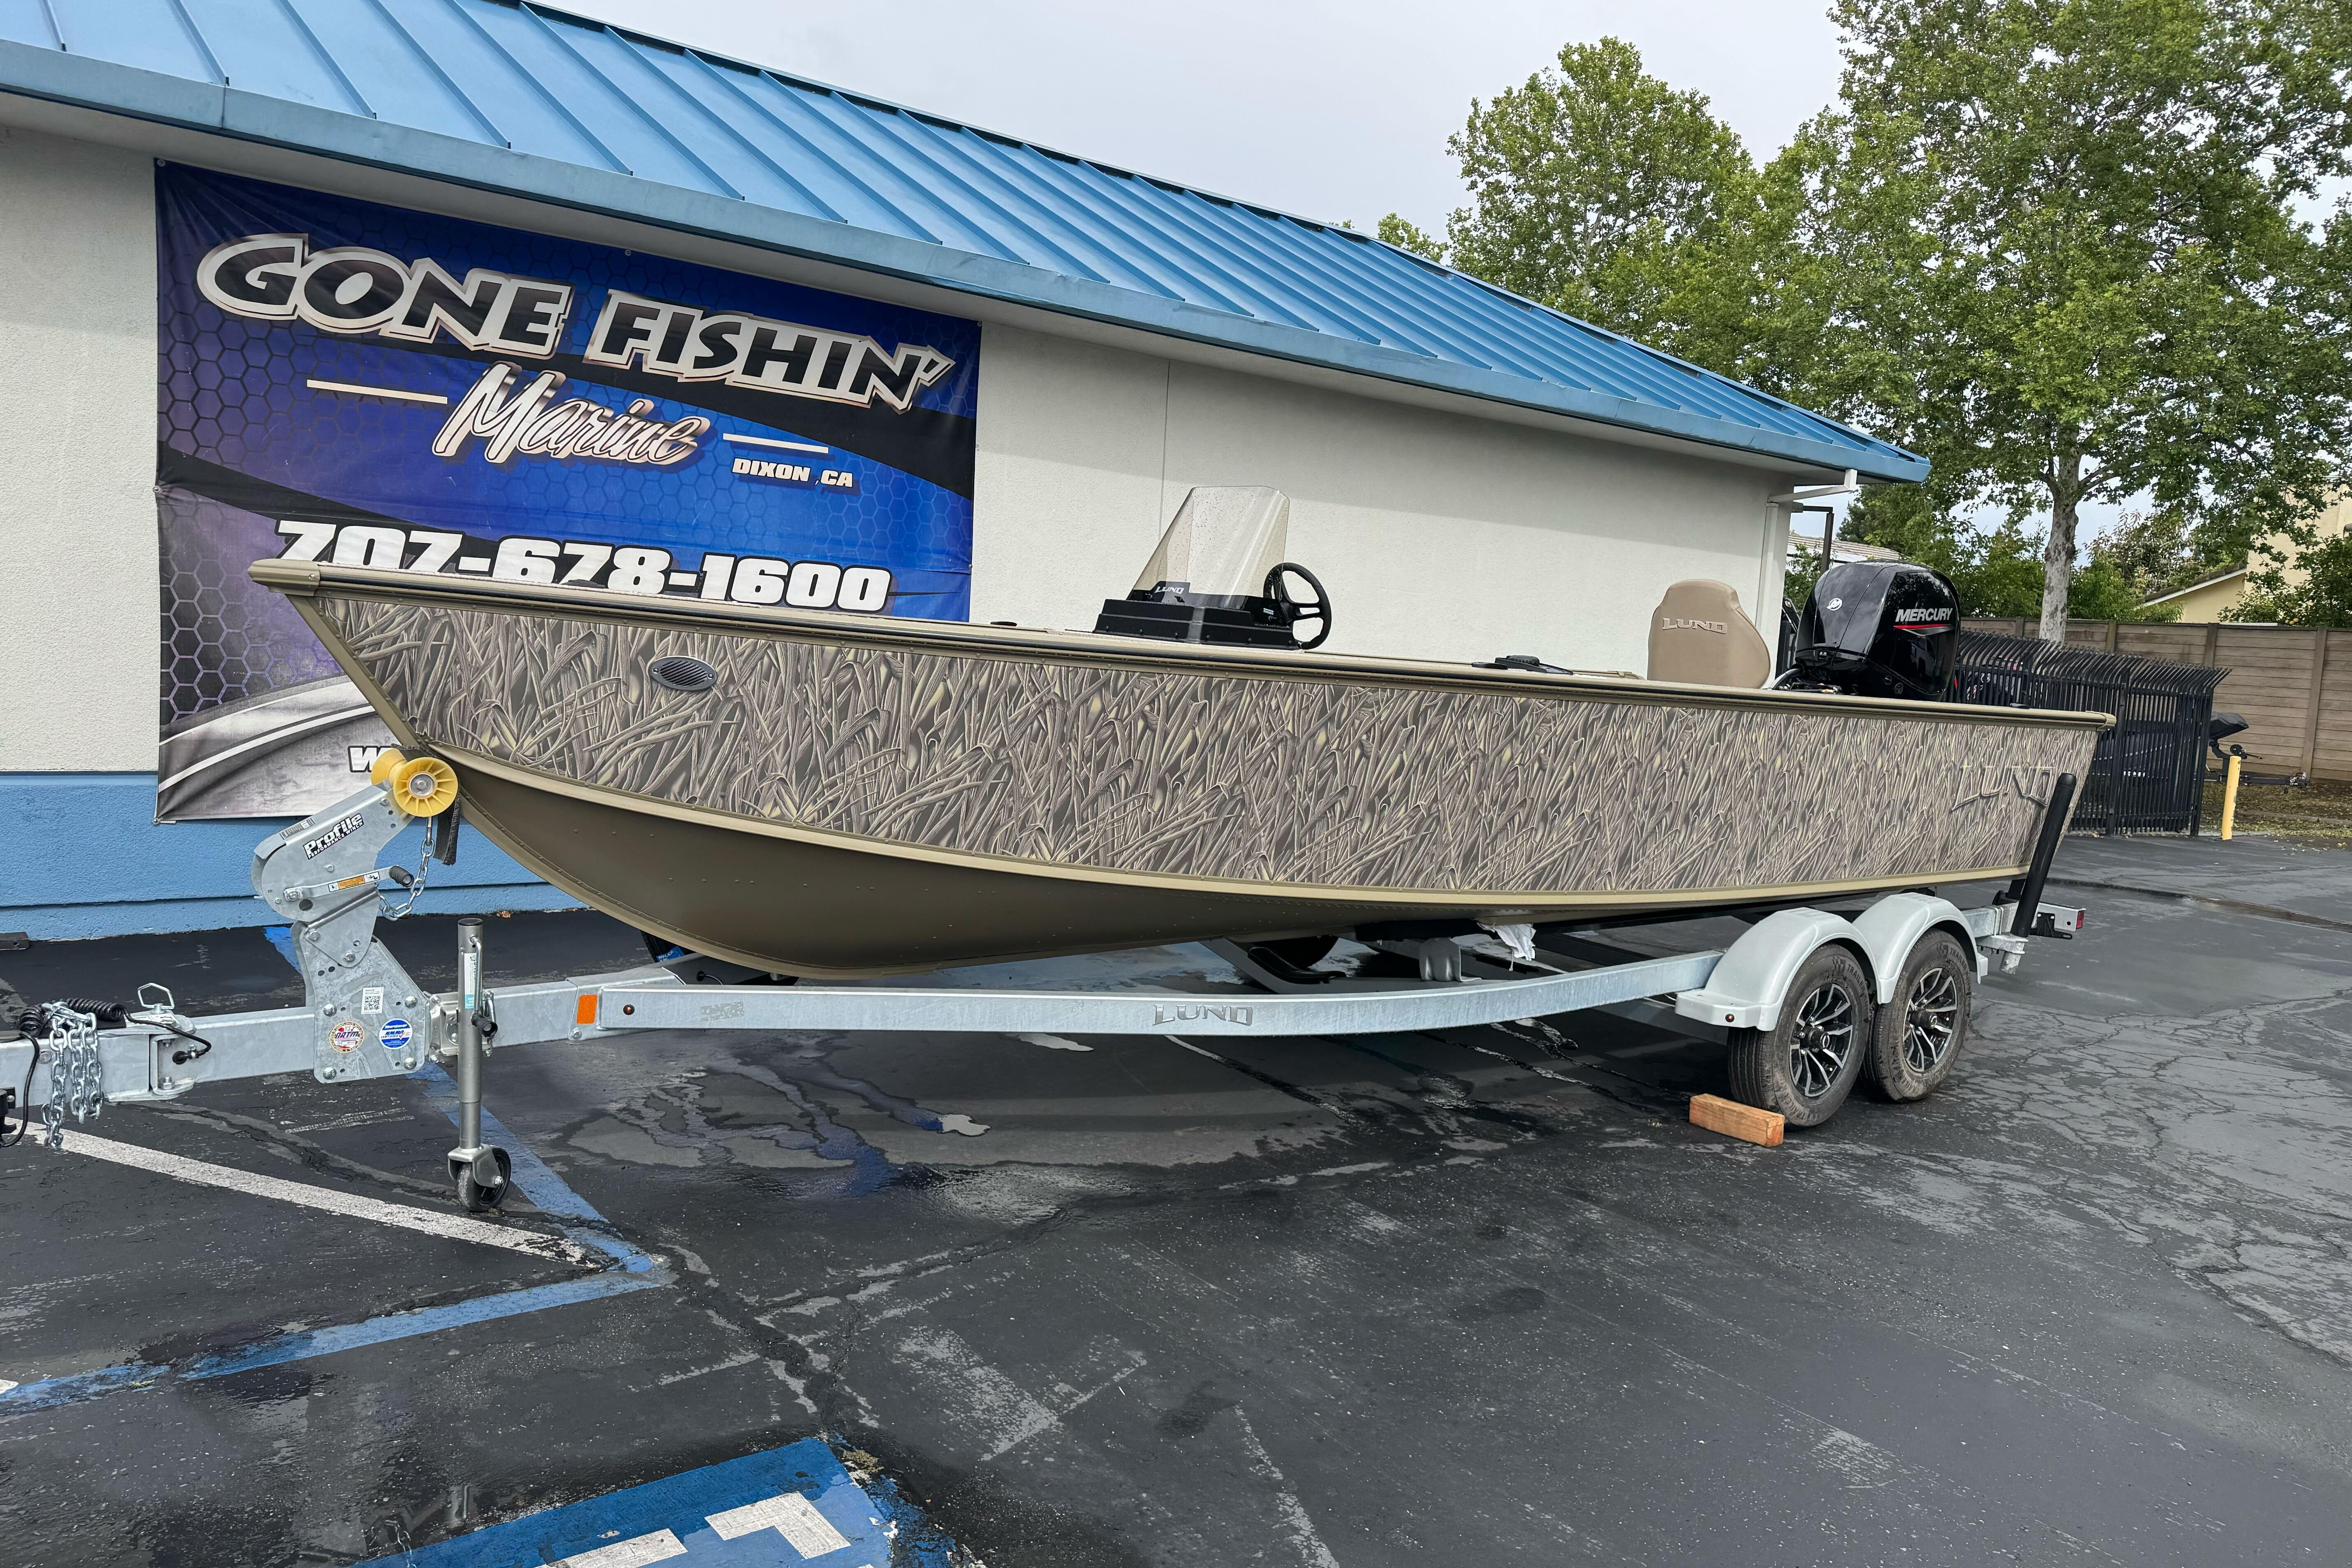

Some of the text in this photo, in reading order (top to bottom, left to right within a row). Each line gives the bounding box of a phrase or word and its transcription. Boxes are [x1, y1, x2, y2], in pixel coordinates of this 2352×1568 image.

[198, 234, 955, 413] GONE FISHIN'
[432, 361, 710, 464] Marine
[732, 458, 811, 482] DIXON
[276, 520, 891, 611] 707-678-1600
[1155, 586, 1184, 594] LUND
[1662, 618, 1727, 634] LUND
[1895, 608, 1953, 622] MERCURY
[1952, 765, 2056, 810] LUND
[304, 814, 362, 855] Profile
[308, 822, 363, 859] PERFORMANCE WINCH
[1153, 1003, 1253, 1026] LUND
